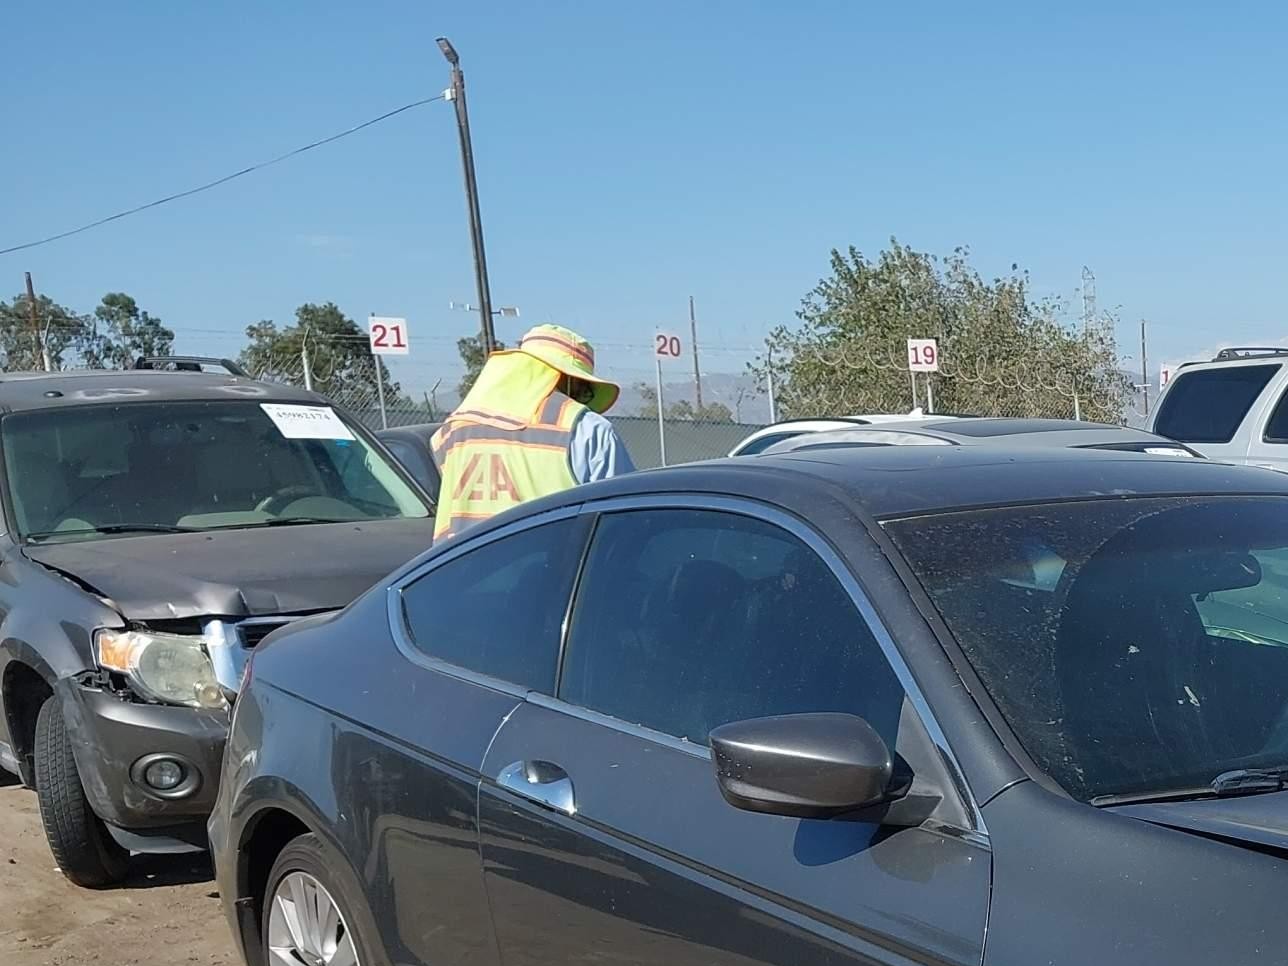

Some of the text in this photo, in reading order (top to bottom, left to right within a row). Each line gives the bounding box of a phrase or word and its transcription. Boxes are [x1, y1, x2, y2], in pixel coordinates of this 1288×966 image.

[372, 324, 407, 348] 21
[656, 334, 681, 357] 20
[910, 345, 935, 365] 19
